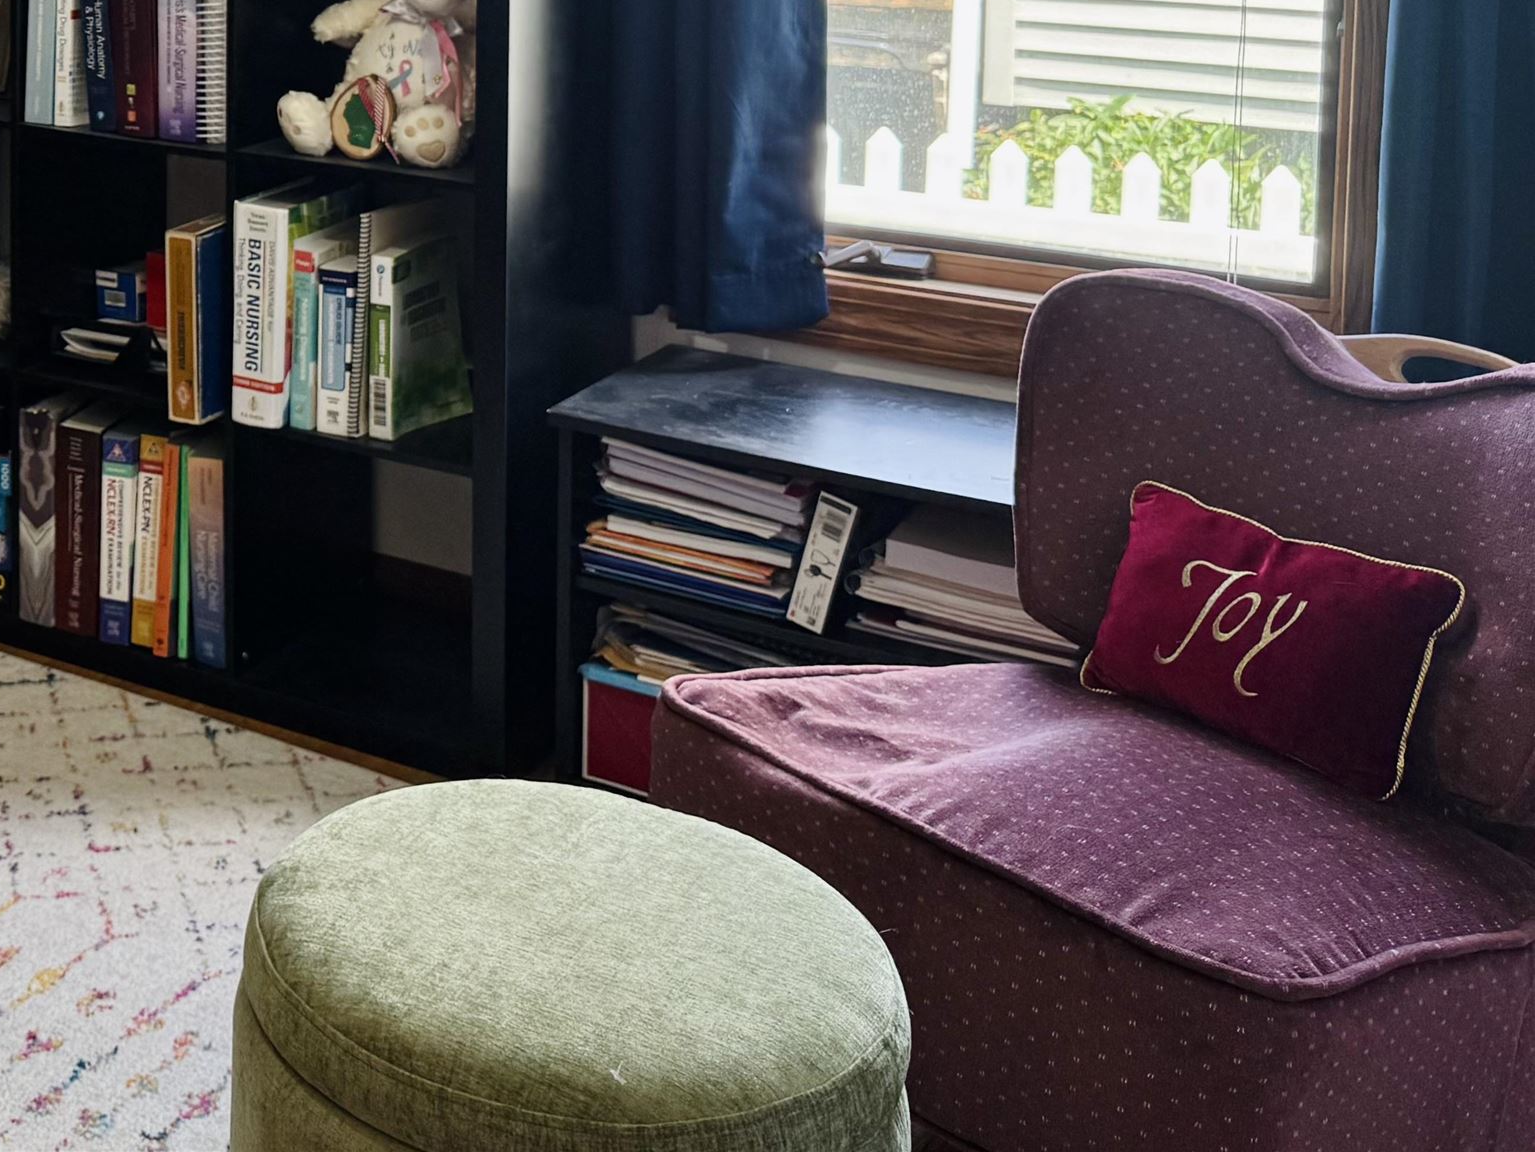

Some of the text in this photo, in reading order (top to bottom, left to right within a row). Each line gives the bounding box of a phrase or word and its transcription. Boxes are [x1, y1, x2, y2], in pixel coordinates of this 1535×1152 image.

[56, 17, 68, 36] Drug
[84, 5, 97, 70] & Physiology
[95, 34, 107, 80] Anatomy
[247, 238, 262, 290] BASIC
[244, 294, 261, 372] NURSING
[0, 463, 11, 490] 1000
[70, 557, 83, 598] Nursing
[1153, 559, 1309, 697] Joy
